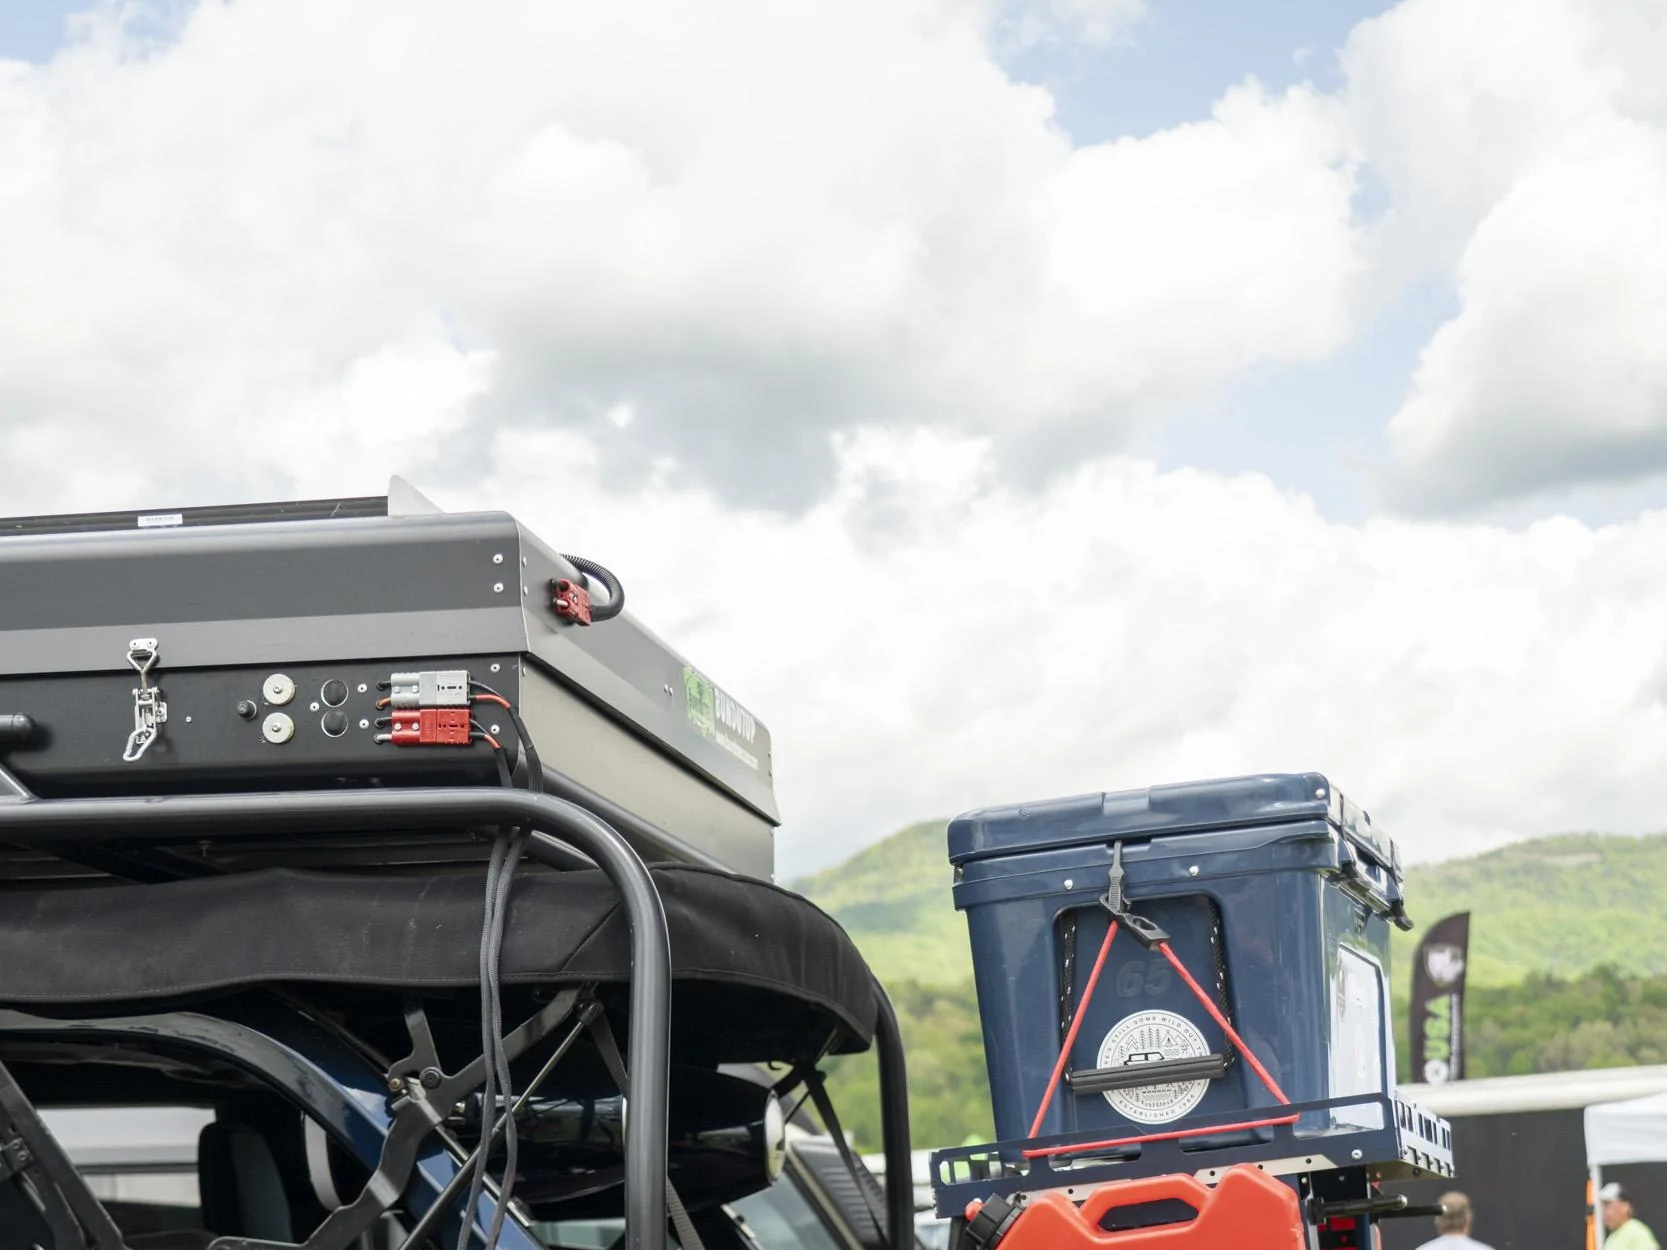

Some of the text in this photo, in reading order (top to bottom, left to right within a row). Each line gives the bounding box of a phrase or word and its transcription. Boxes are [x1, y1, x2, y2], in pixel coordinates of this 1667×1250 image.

[1117, 958, 1172, 997] 65
[1112, 1025, 1129, 1043] STILL
[1133, 1016, 1156, 1024] SOME
[1161, 1016, 1182, 1027] WILD
[1184, 1028, 1198, 1043] OUT
[1424, 993, 1450, 1060] USA
[1119, 1099, 1175, 1118] ESTABLISHED
